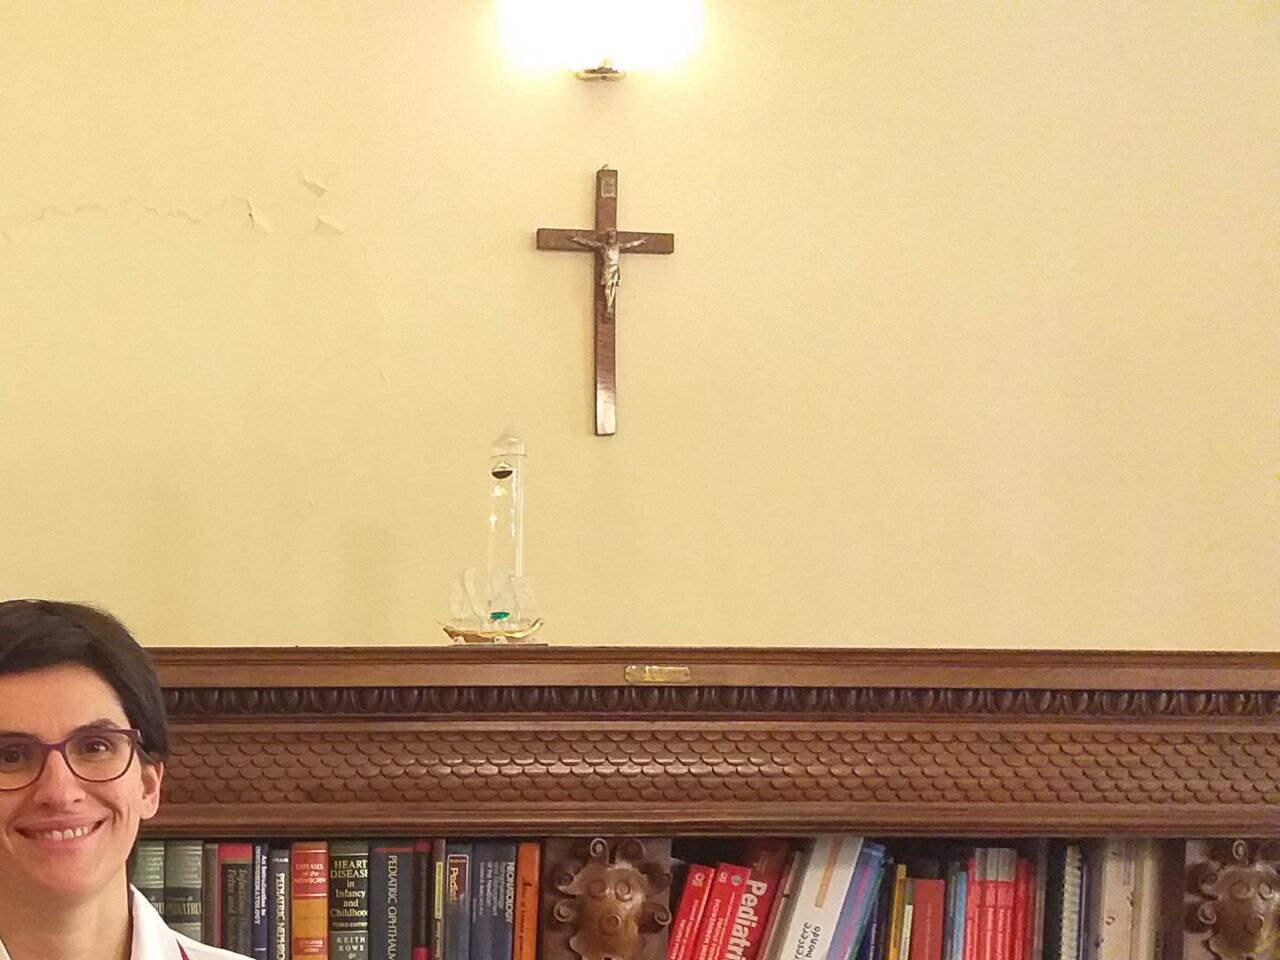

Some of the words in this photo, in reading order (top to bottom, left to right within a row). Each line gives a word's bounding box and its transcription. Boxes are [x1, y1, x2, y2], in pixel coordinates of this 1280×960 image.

[261, 854, 268, 865] An
[295, 863, 324, 871] DISEASES
[334, 860, 368, 870] HEART
[309, 870, 320, 878] the
[387, 854, 398, 904] PEDIATRIC
[294, 877, 327, 885] NEWBORN
[347, 880, 355, 888] in
[260, 865, 268, 908] Introduction
[276, 872, 286, 921] PEDIATRIC
[335, 889, 366, 900] Infancy
[504, 861, 516, 924] NEONATOLOGY
[343, 899, 359, 908] and
[260, 908, 267, 917] to
[330, 907, 368, 918] Childhoo
[336, 936, 366, 944] KEITH
[805, 925, 822, 959] mondo
[338, 944, 364, 952] ROWE
